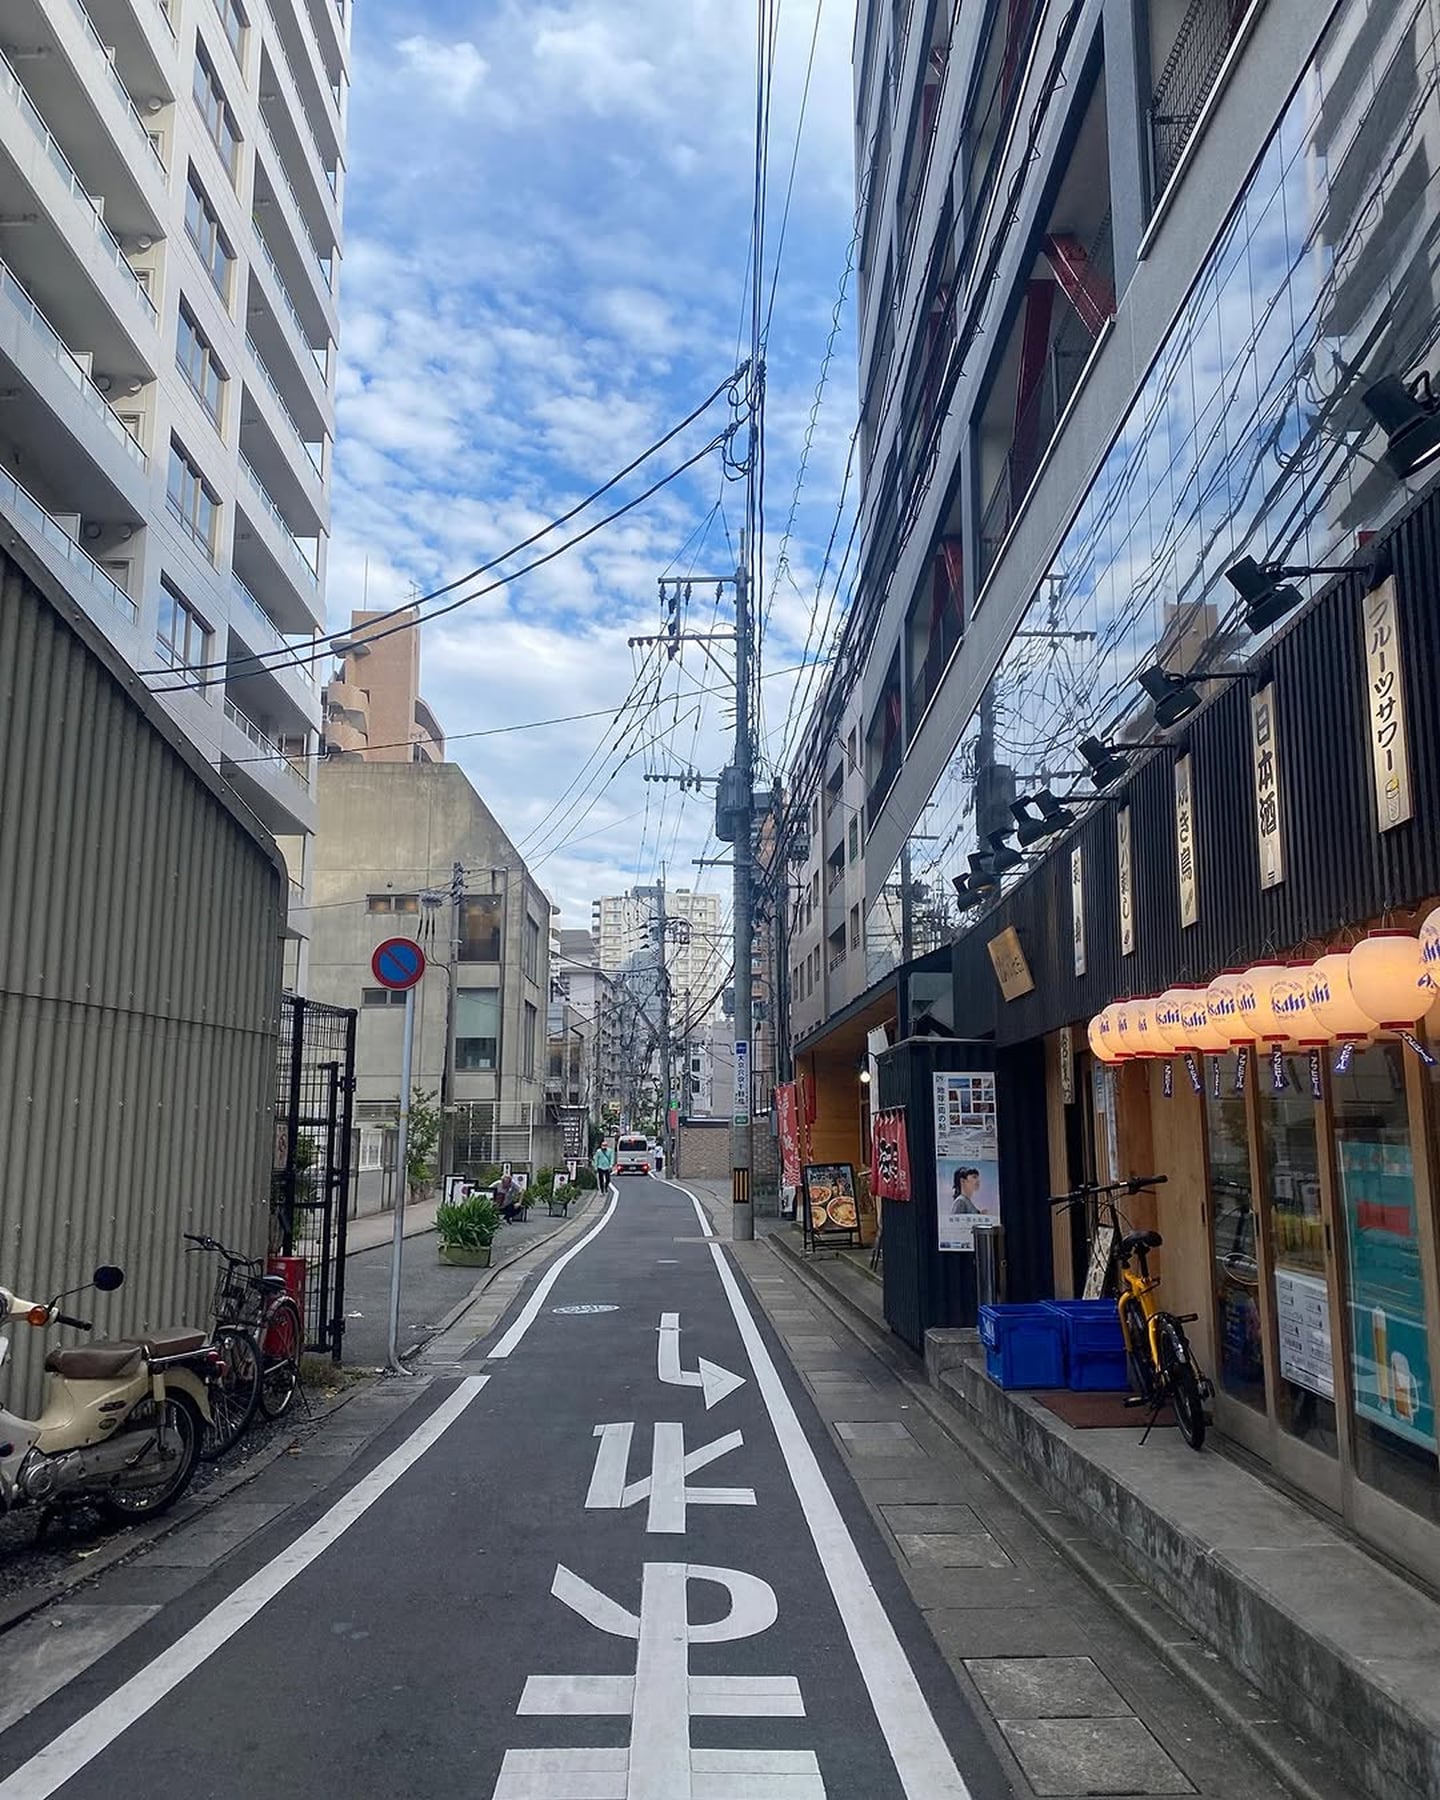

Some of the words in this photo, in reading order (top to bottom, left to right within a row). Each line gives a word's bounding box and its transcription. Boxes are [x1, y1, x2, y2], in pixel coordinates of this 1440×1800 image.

[1368, 602, 1397, 771] フルーツサワー
[1256, 704, 1277, 837] 日本酒
[937, 1086, 947, 1140] 地球一周の船旅
